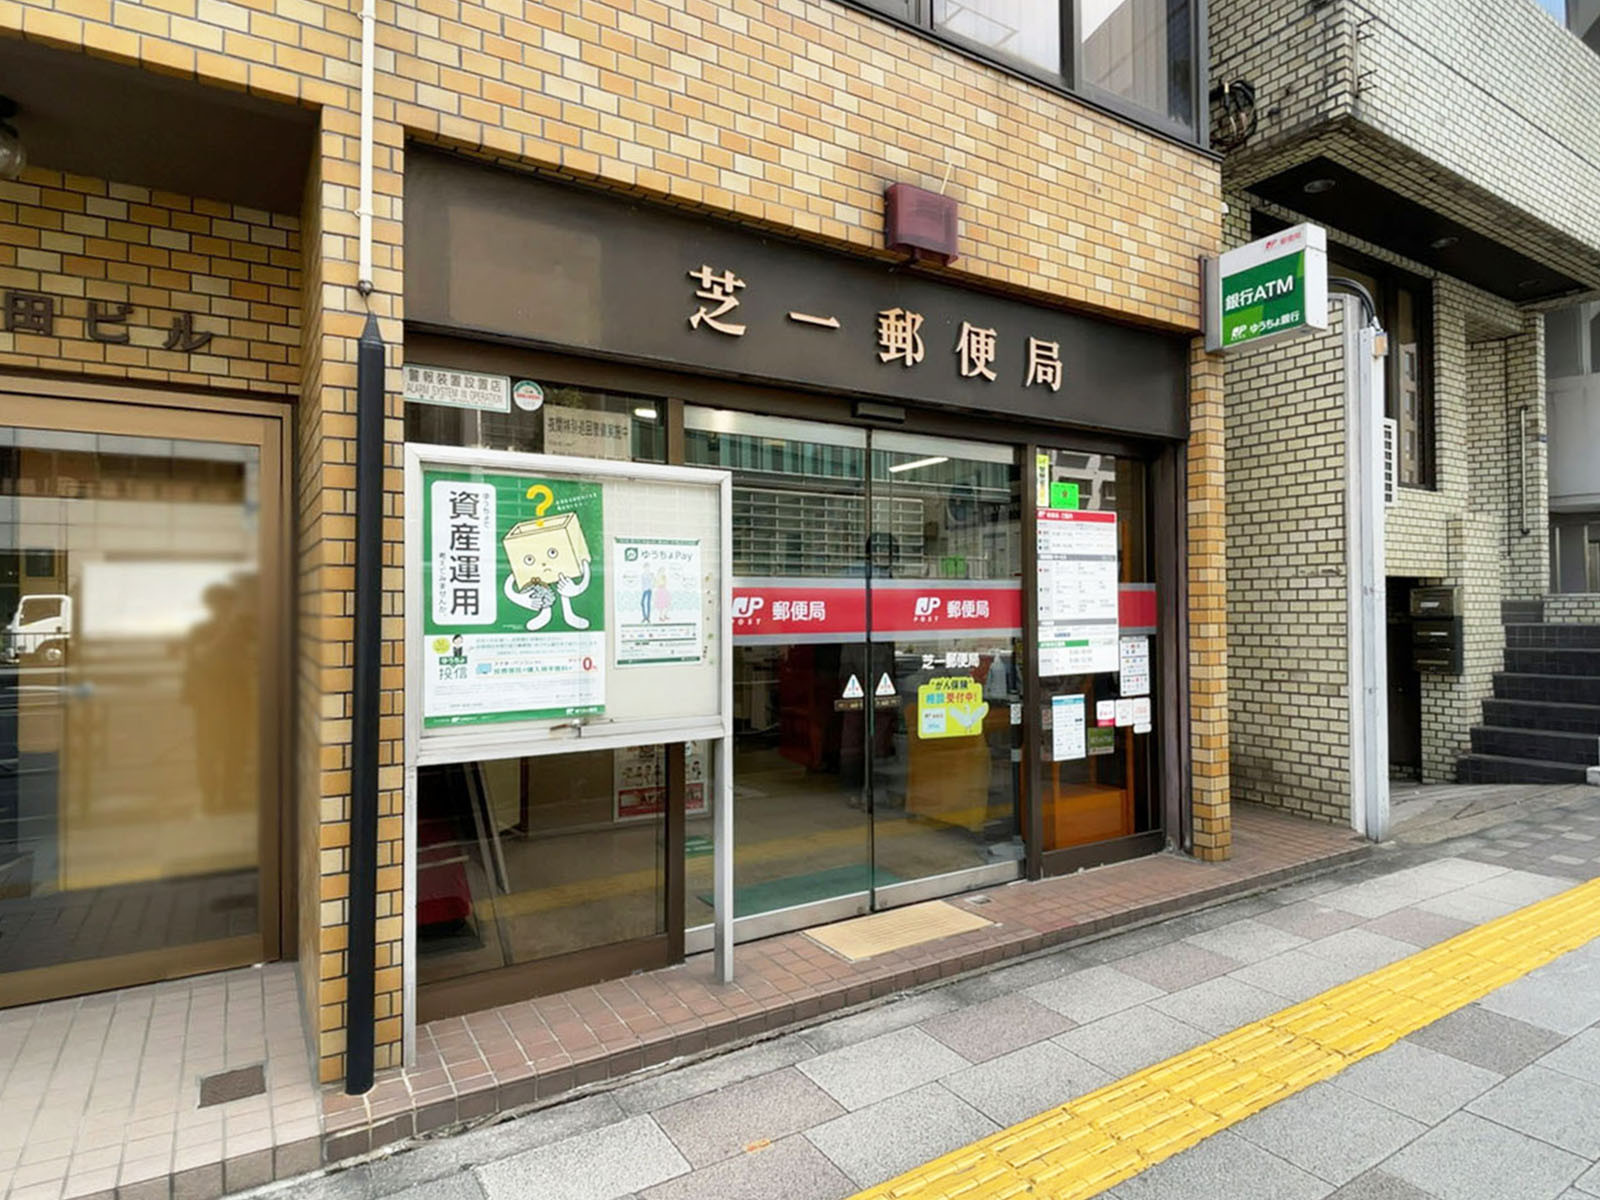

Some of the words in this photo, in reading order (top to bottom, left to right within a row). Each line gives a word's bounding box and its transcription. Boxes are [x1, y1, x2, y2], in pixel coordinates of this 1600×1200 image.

[1225, 275, 1293, 311] 銀行ATM
[688, 264, 1063, 392] 芝一郵便局
[1249, 310, 1300, 333] ゆうちょ銀行
[408, 368, 501, 393] 警報装置設置店
[449, 490, 481, 616] 資産運用
[641, 550, 694, 562] ゆうちょPay
[772, 601, 826, 622] 郵便局
[947, 600, 989, 619] 郵便局
[921, 652, 981, 670] 芝一郵便局
[439, 667, 468, 681] 投信
